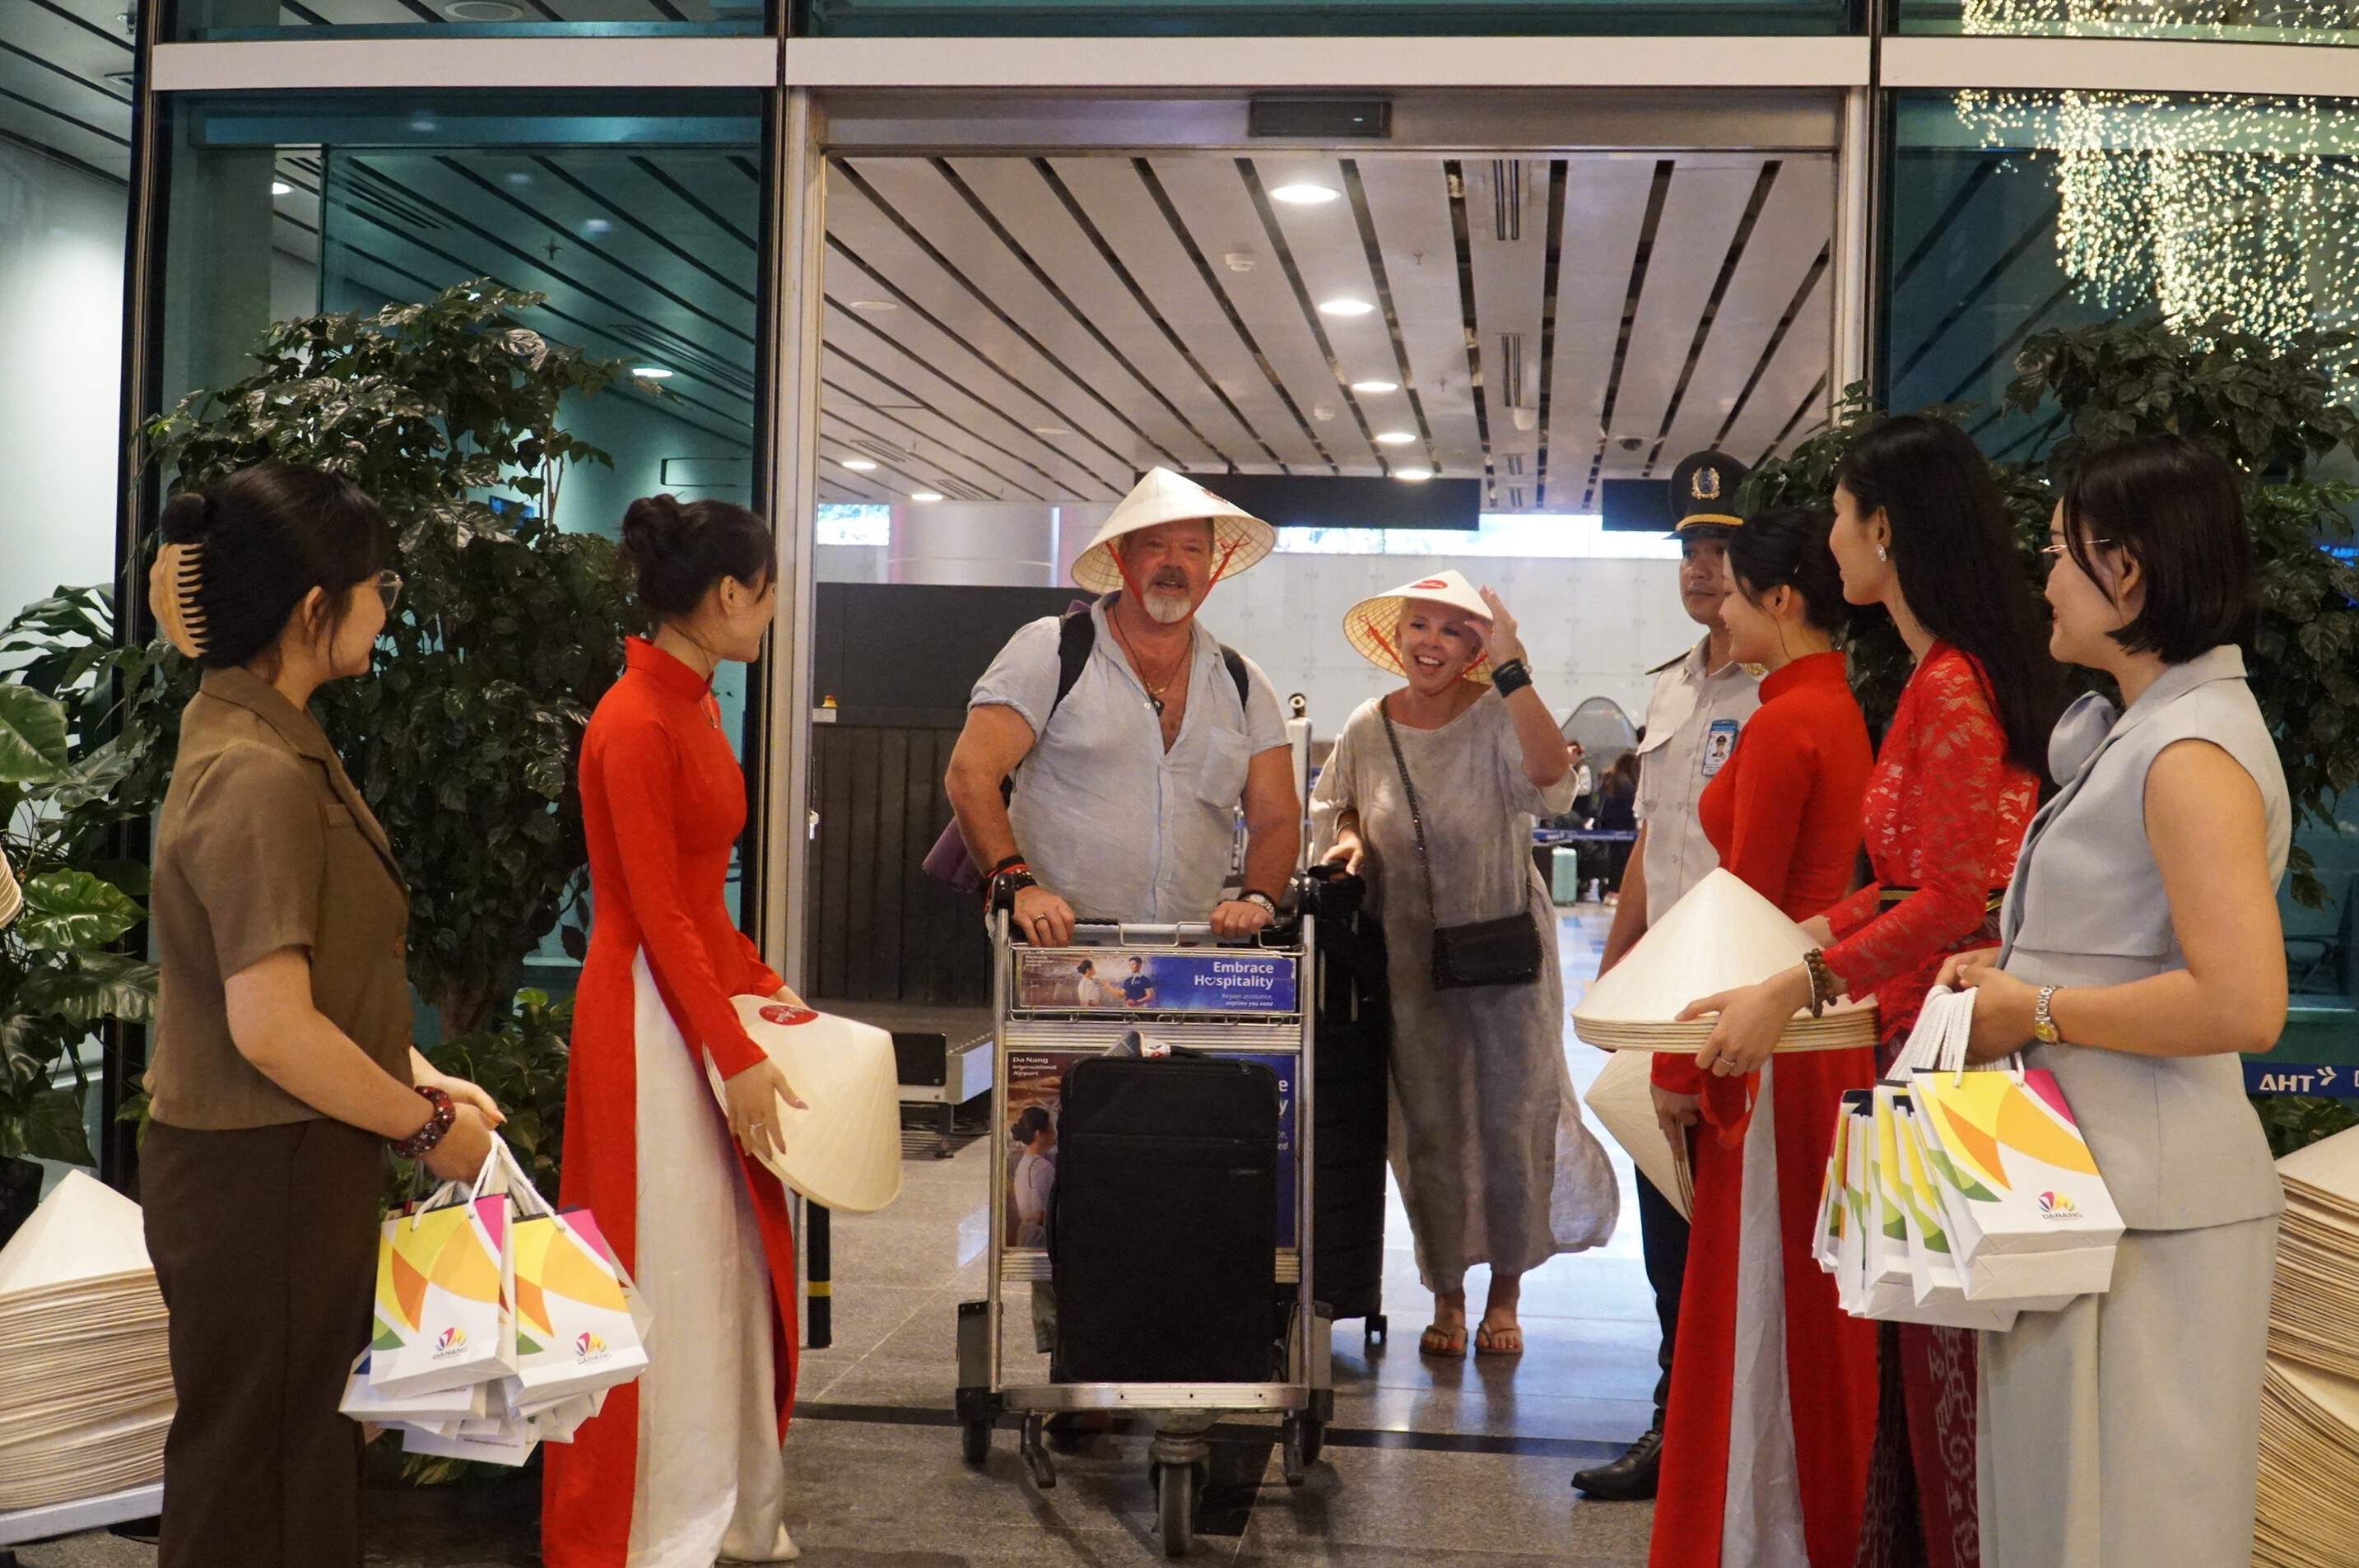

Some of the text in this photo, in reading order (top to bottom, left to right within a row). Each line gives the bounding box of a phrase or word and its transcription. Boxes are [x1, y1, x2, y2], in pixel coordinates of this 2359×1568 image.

[1213, 961, 1274, 973] Embrace
[2259, 1073, 2315, 1093] AHT
[432, 1347, 468, 1359] DANANG
